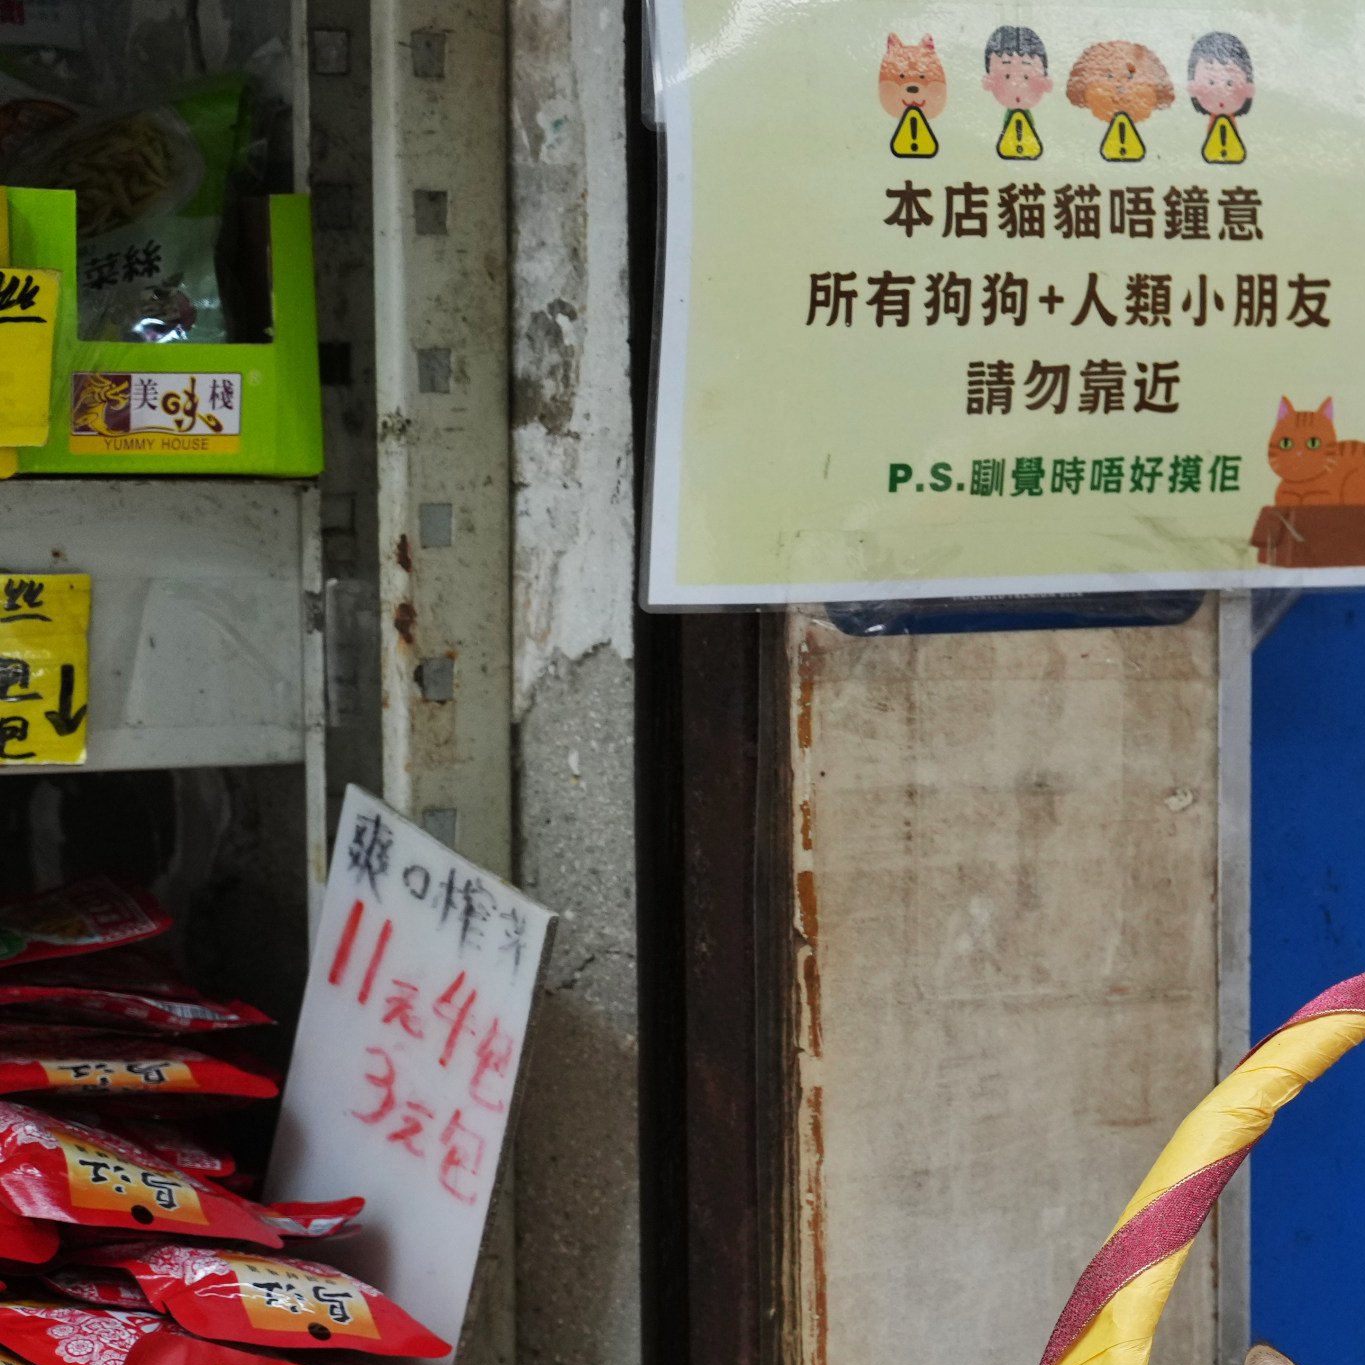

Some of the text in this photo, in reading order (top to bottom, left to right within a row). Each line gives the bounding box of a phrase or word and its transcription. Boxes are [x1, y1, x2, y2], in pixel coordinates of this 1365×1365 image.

[884, 181, 1264, 241] 本店貓貓唔鐘意
[805, 272, 1333, 330] 所有狗狗+人類小朋友
[966, 360, 1181, 417] 請勿靠近
[104, 436, 209, 451] YUMMY HOUSE
